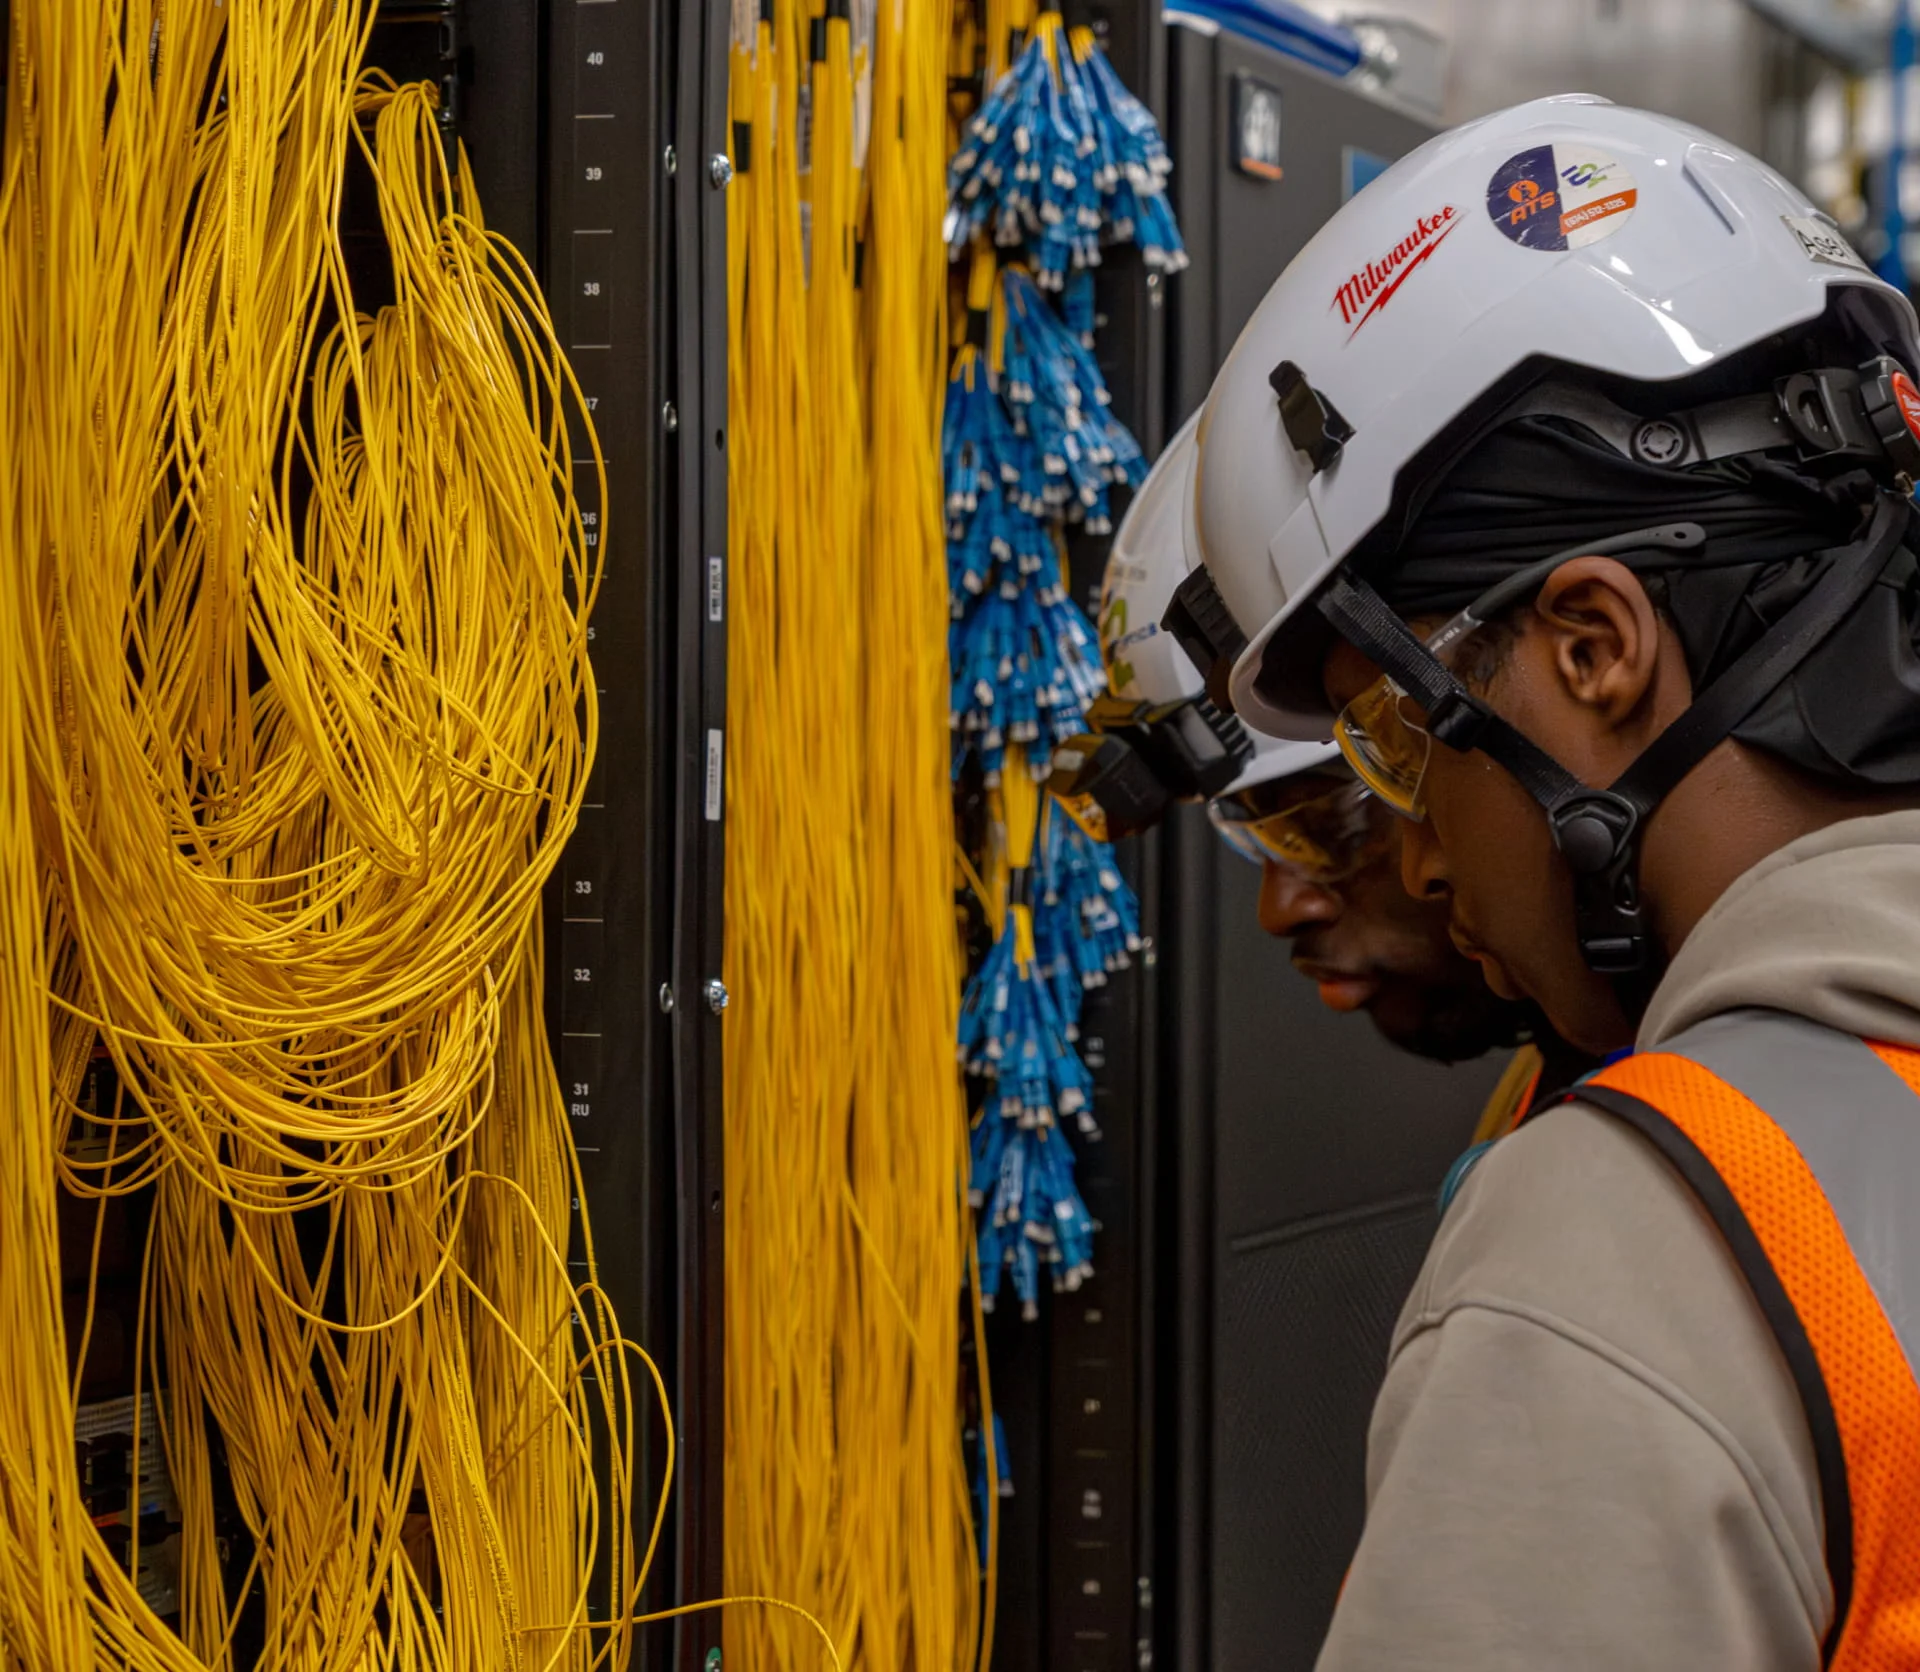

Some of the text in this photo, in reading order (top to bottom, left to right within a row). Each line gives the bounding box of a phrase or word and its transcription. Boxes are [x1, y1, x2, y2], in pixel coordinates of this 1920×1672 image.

[587, 52, 604, 65] 40
[585, 167, 602, 181] 39
[1510, 190, 1556, 226] ATS
[1329, 205, 1457, 324] Milwaukee
[583, 282, 600, 296] 38
[581, 511, 597, 525] 36
[575, 880, 592, 894] 33
[573, 968, 591, 982] 32
[573, 1083, 589, 1096] 31
[571, 1103, 590, 1117] RU
